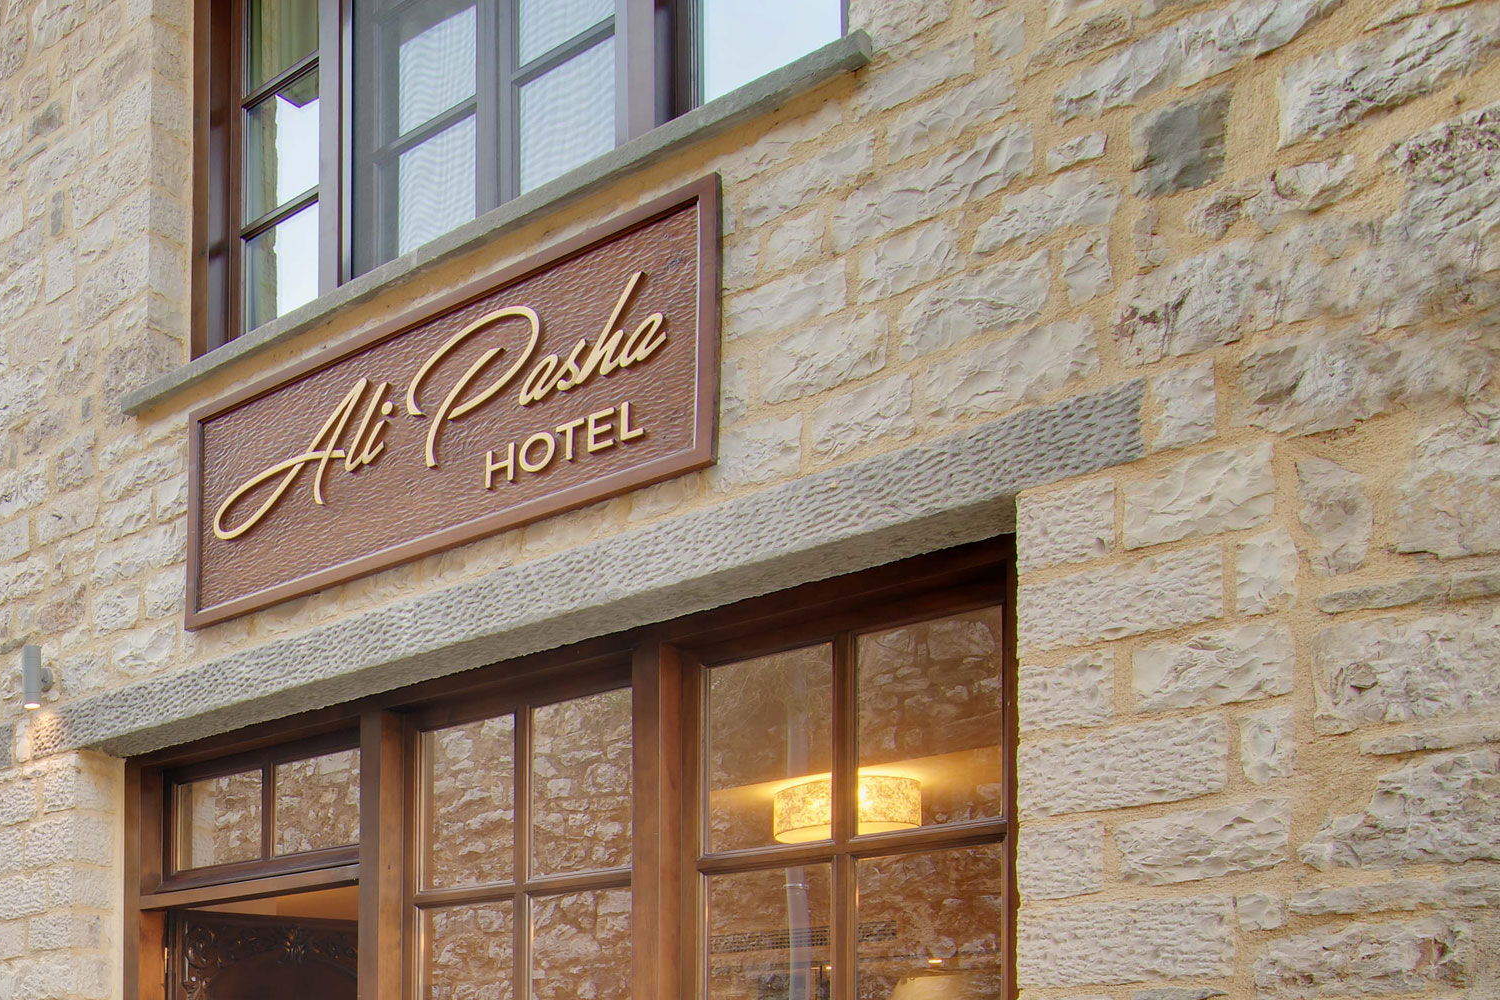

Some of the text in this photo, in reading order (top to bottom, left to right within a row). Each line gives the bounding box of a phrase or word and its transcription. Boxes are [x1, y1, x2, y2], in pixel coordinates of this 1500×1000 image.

[212, 270, 668, 541] Ali Pasha
[484, 400, 646, 490] HOTEL
